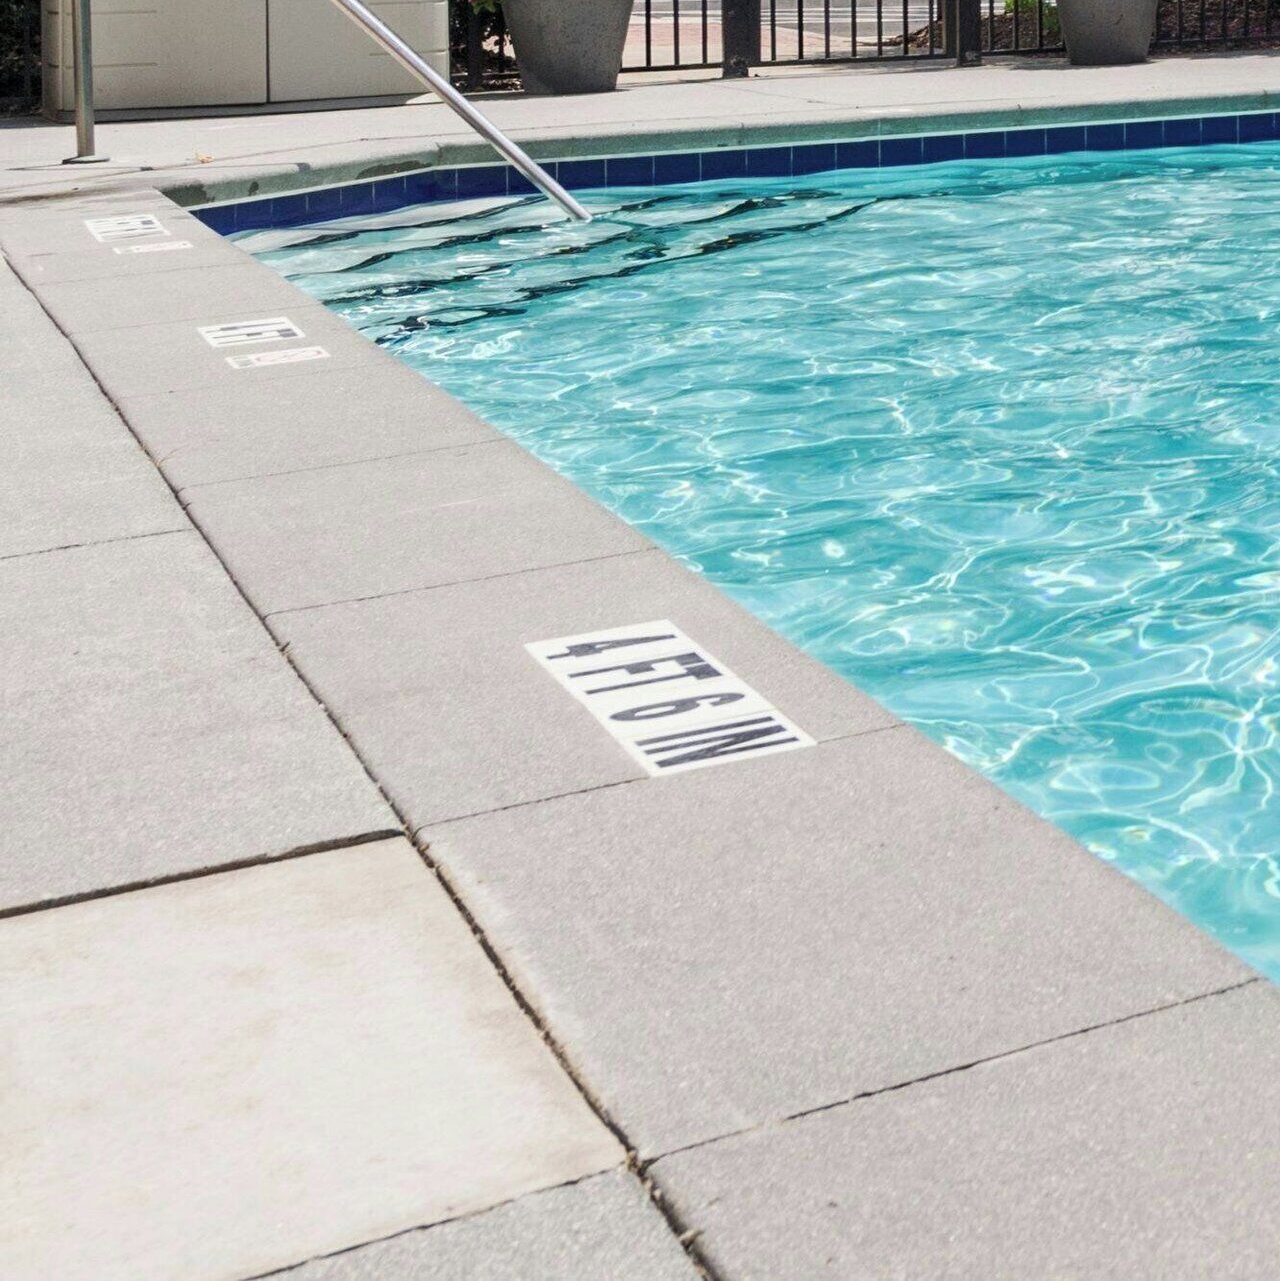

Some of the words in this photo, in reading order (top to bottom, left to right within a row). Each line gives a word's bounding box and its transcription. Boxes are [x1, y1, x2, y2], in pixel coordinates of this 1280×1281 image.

[546, 633, 678, 661] 4
[567, 651, 724, 695] FT
[609, 691, 746, 722] 6
[634, 715, 800, 769] IN
